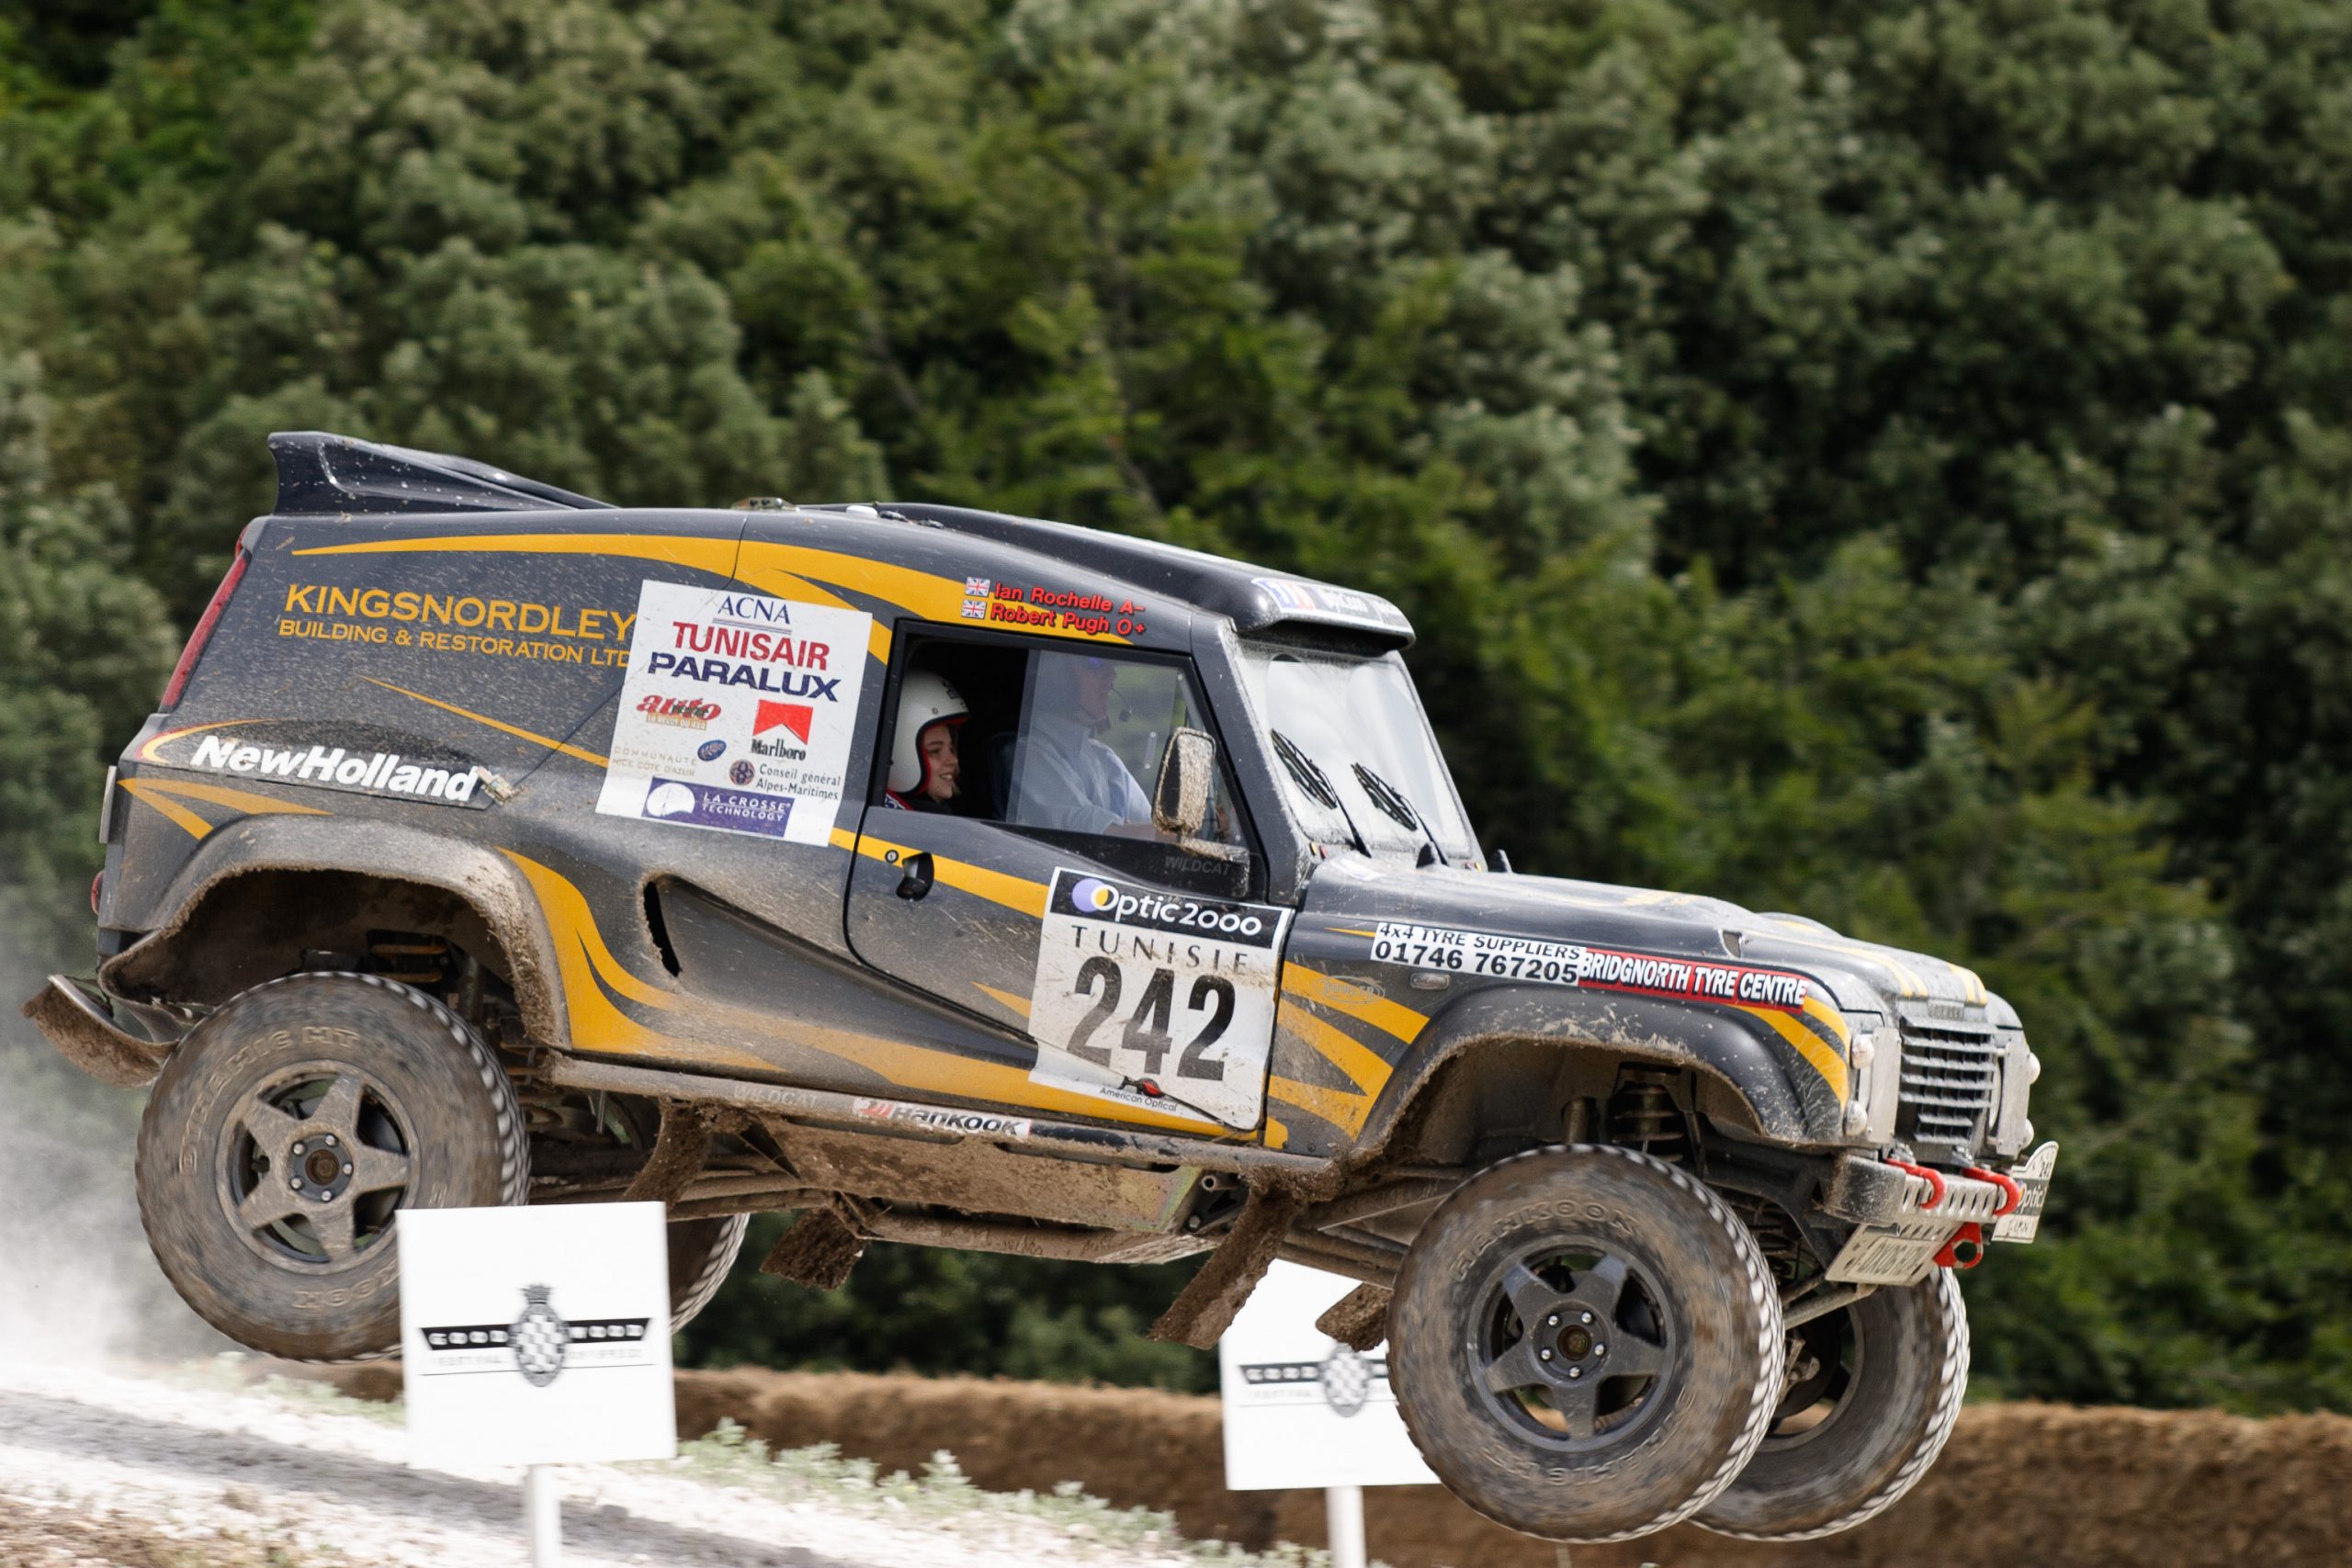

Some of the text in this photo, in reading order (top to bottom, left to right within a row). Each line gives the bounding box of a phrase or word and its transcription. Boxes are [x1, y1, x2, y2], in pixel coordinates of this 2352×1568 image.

[284, 583, 637, 642] KINGSNORDLEY
[718, 595, 791, 625] ACNA
[994, 581, 1023, 602] Ian
[1030, 587, 1113, 613] Rochelle
[989, 603, 1057, 627] Robert
[1062, 611, 1111, 635] Pugh
[278, 619, 631, 669] BUILDING & RESTORATION LTD
[673, 621, 831, 671] TUNISAIR
[647, 651, 842, 703] PARALUX
[751, 738, 807, 761] Marlboro
[755, 778, 839, 800] Alpes-Maritimes
[759, 763, 842, 786] Conseil général
[702, 804, 785, 822] TECHNOLOGY
[703, 792, 786, 812] LA CROSSE
[1165, 855, 1232, 875] WILDCAT
[1071, 924, 1249, 975] TUNISIE
[1379, 922, 1581, 961] 4x4 TYRE SUPPLIERS
[1374, 941, 1578, 984] 01746 767205
[1579, 952, 1810, 1008] BRIDGNORTH TYRE CENTRE
[1066, 955, 1237, 1082] 242
[1099, 1086, 1178, 1113] American Optical
